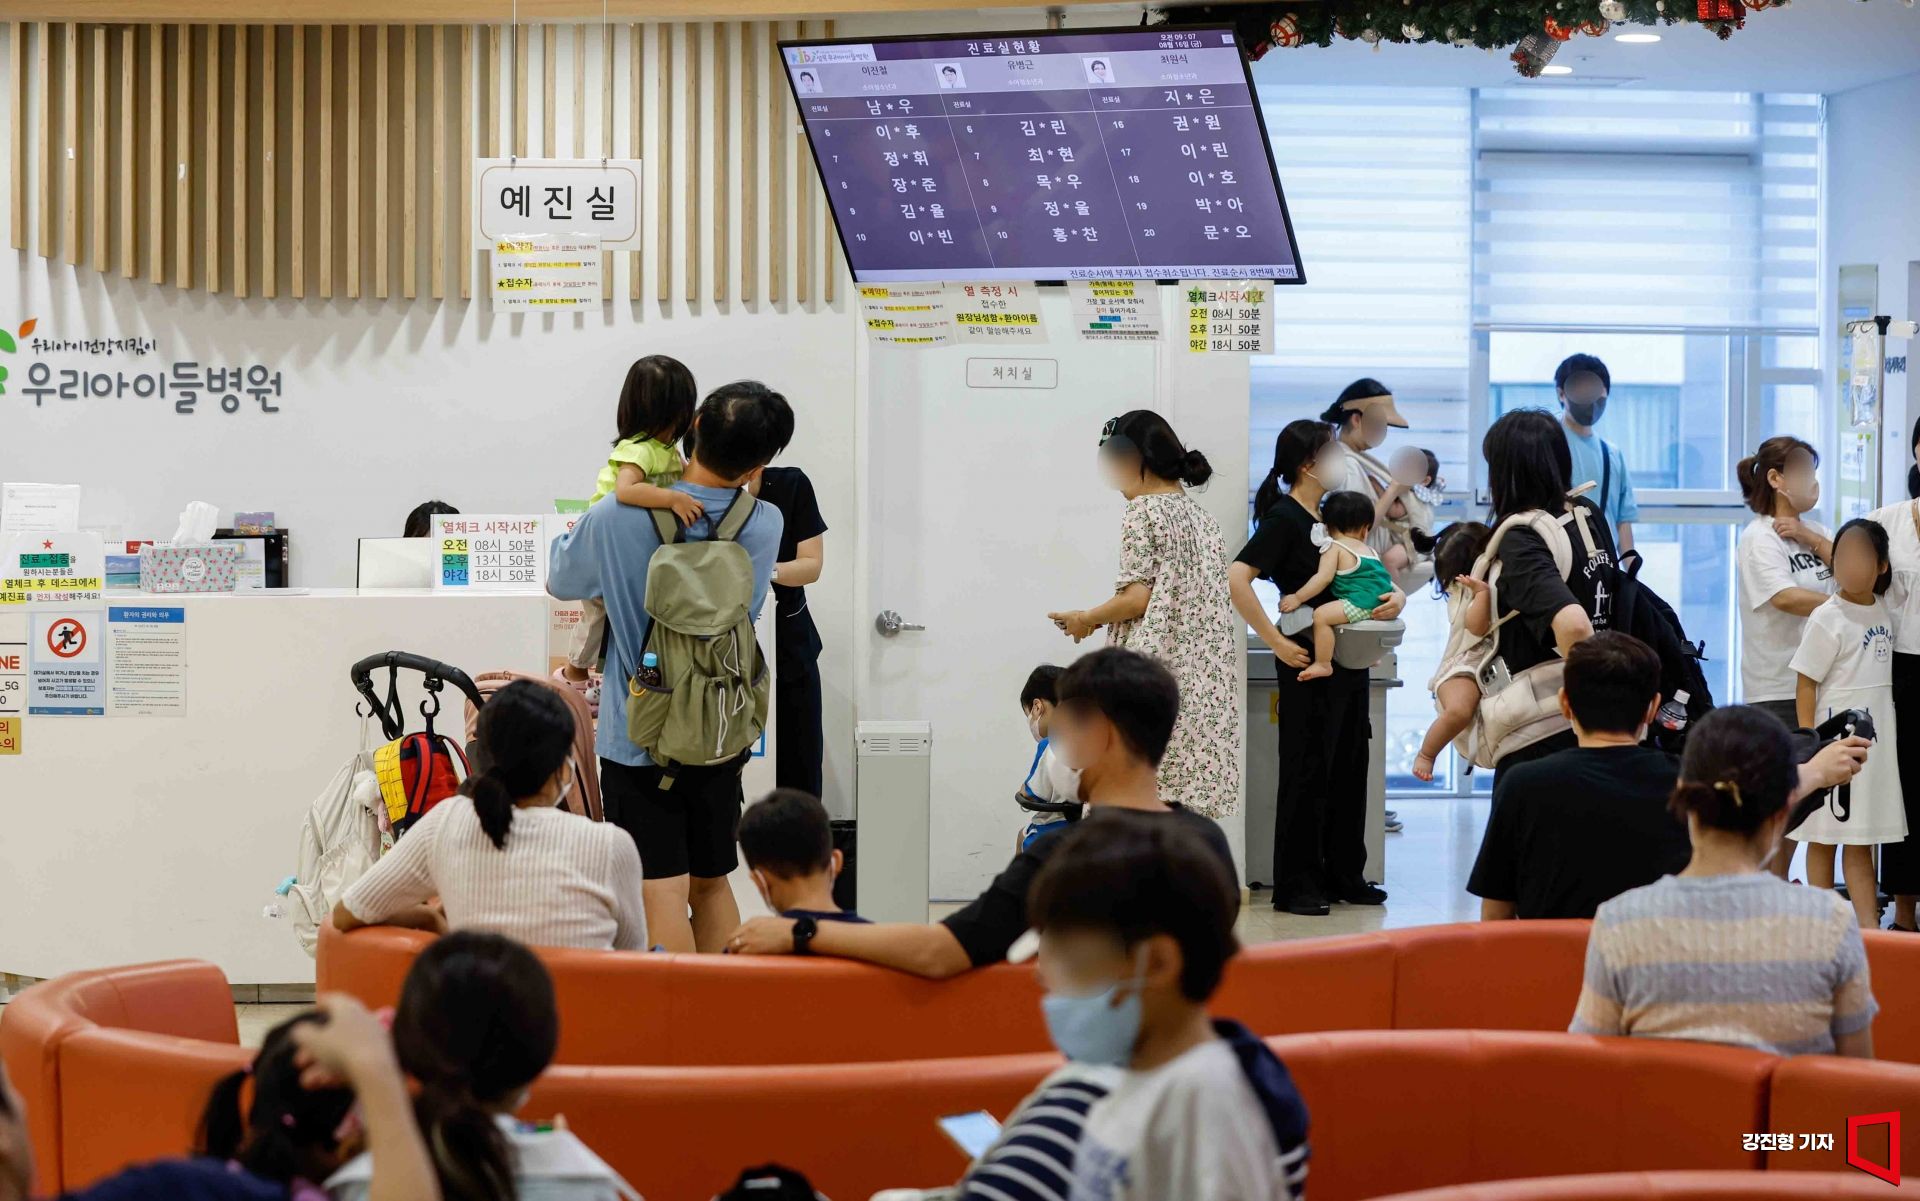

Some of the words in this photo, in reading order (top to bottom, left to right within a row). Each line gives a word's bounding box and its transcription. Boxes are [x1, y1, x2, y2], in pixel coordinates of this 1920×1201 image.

[967, 41, 1040, 55] 진료실현황
[1112, 120, 1125, 129] 16
[824, 128, 831, 137] 6
[966, 125, 973, 134] 6
[974, 152, 981, 160] 7
[1121, 148, 1131, 157] 17
[833, 155, 839, 163] 7
[983, 178, 989, 187] 8
[1128, 175, 1140, 184] 18
[500, 185, 615, 221] 예진실
[1136, 202, 1147, 211] 19
[849, 207, 856, 216] 9
[991, 204, 998, 214] 9
[997, 231, 1008, 240] 10
[1143, 228, 1155, 237] 20
[856, 233, 867, 242] 10
[1277, 267, 1297, 277] 전까
[506, 278, 532, 287] 접수자
[964, 286, 975, 297] 열
[980, 286, 1000, 297] 측정
[1008, 286, 1018, 297] 시
[981, 300, 1006, 309] 접수한
[1190, 308, 1208, 319] 오전
[1212, 308, 1233, 319] 08시
[1239, 308, 1260, 319] 50분
[1190, 324, 1208, 335] 오후
[1212, 324, 1232, 335] 13시
[1238, 324, 1260, 335] 50분
[1190, 340, 1208, 350] 야간
[1212, 340, 1232, 351] 18시
[1238, 339, 1260, 350] 50분
[993, 366, 1032, 381] 처치실
[21, 362, 282, 414] 우리아이들병원
[442, 521, 480, 534] 열체크
[484, 521, 535, 534] 시작시간
[443, 539, 468, 552] 오전
[474, 540, 501, 552] 08시
[509, 540, 535, 552] 50분
[443, 555, 468, 566] 오후
[475, 555, 501, 566] 13시
[509, 555, 536, 566] 50분
[443, 569, 468, 581] 야간
[476, 569, 501, 581] 18시
[509, 569, 536, 581] 50분
[5, 579, 32, 588] 열체크
[37, 579, 46, 588] 후
